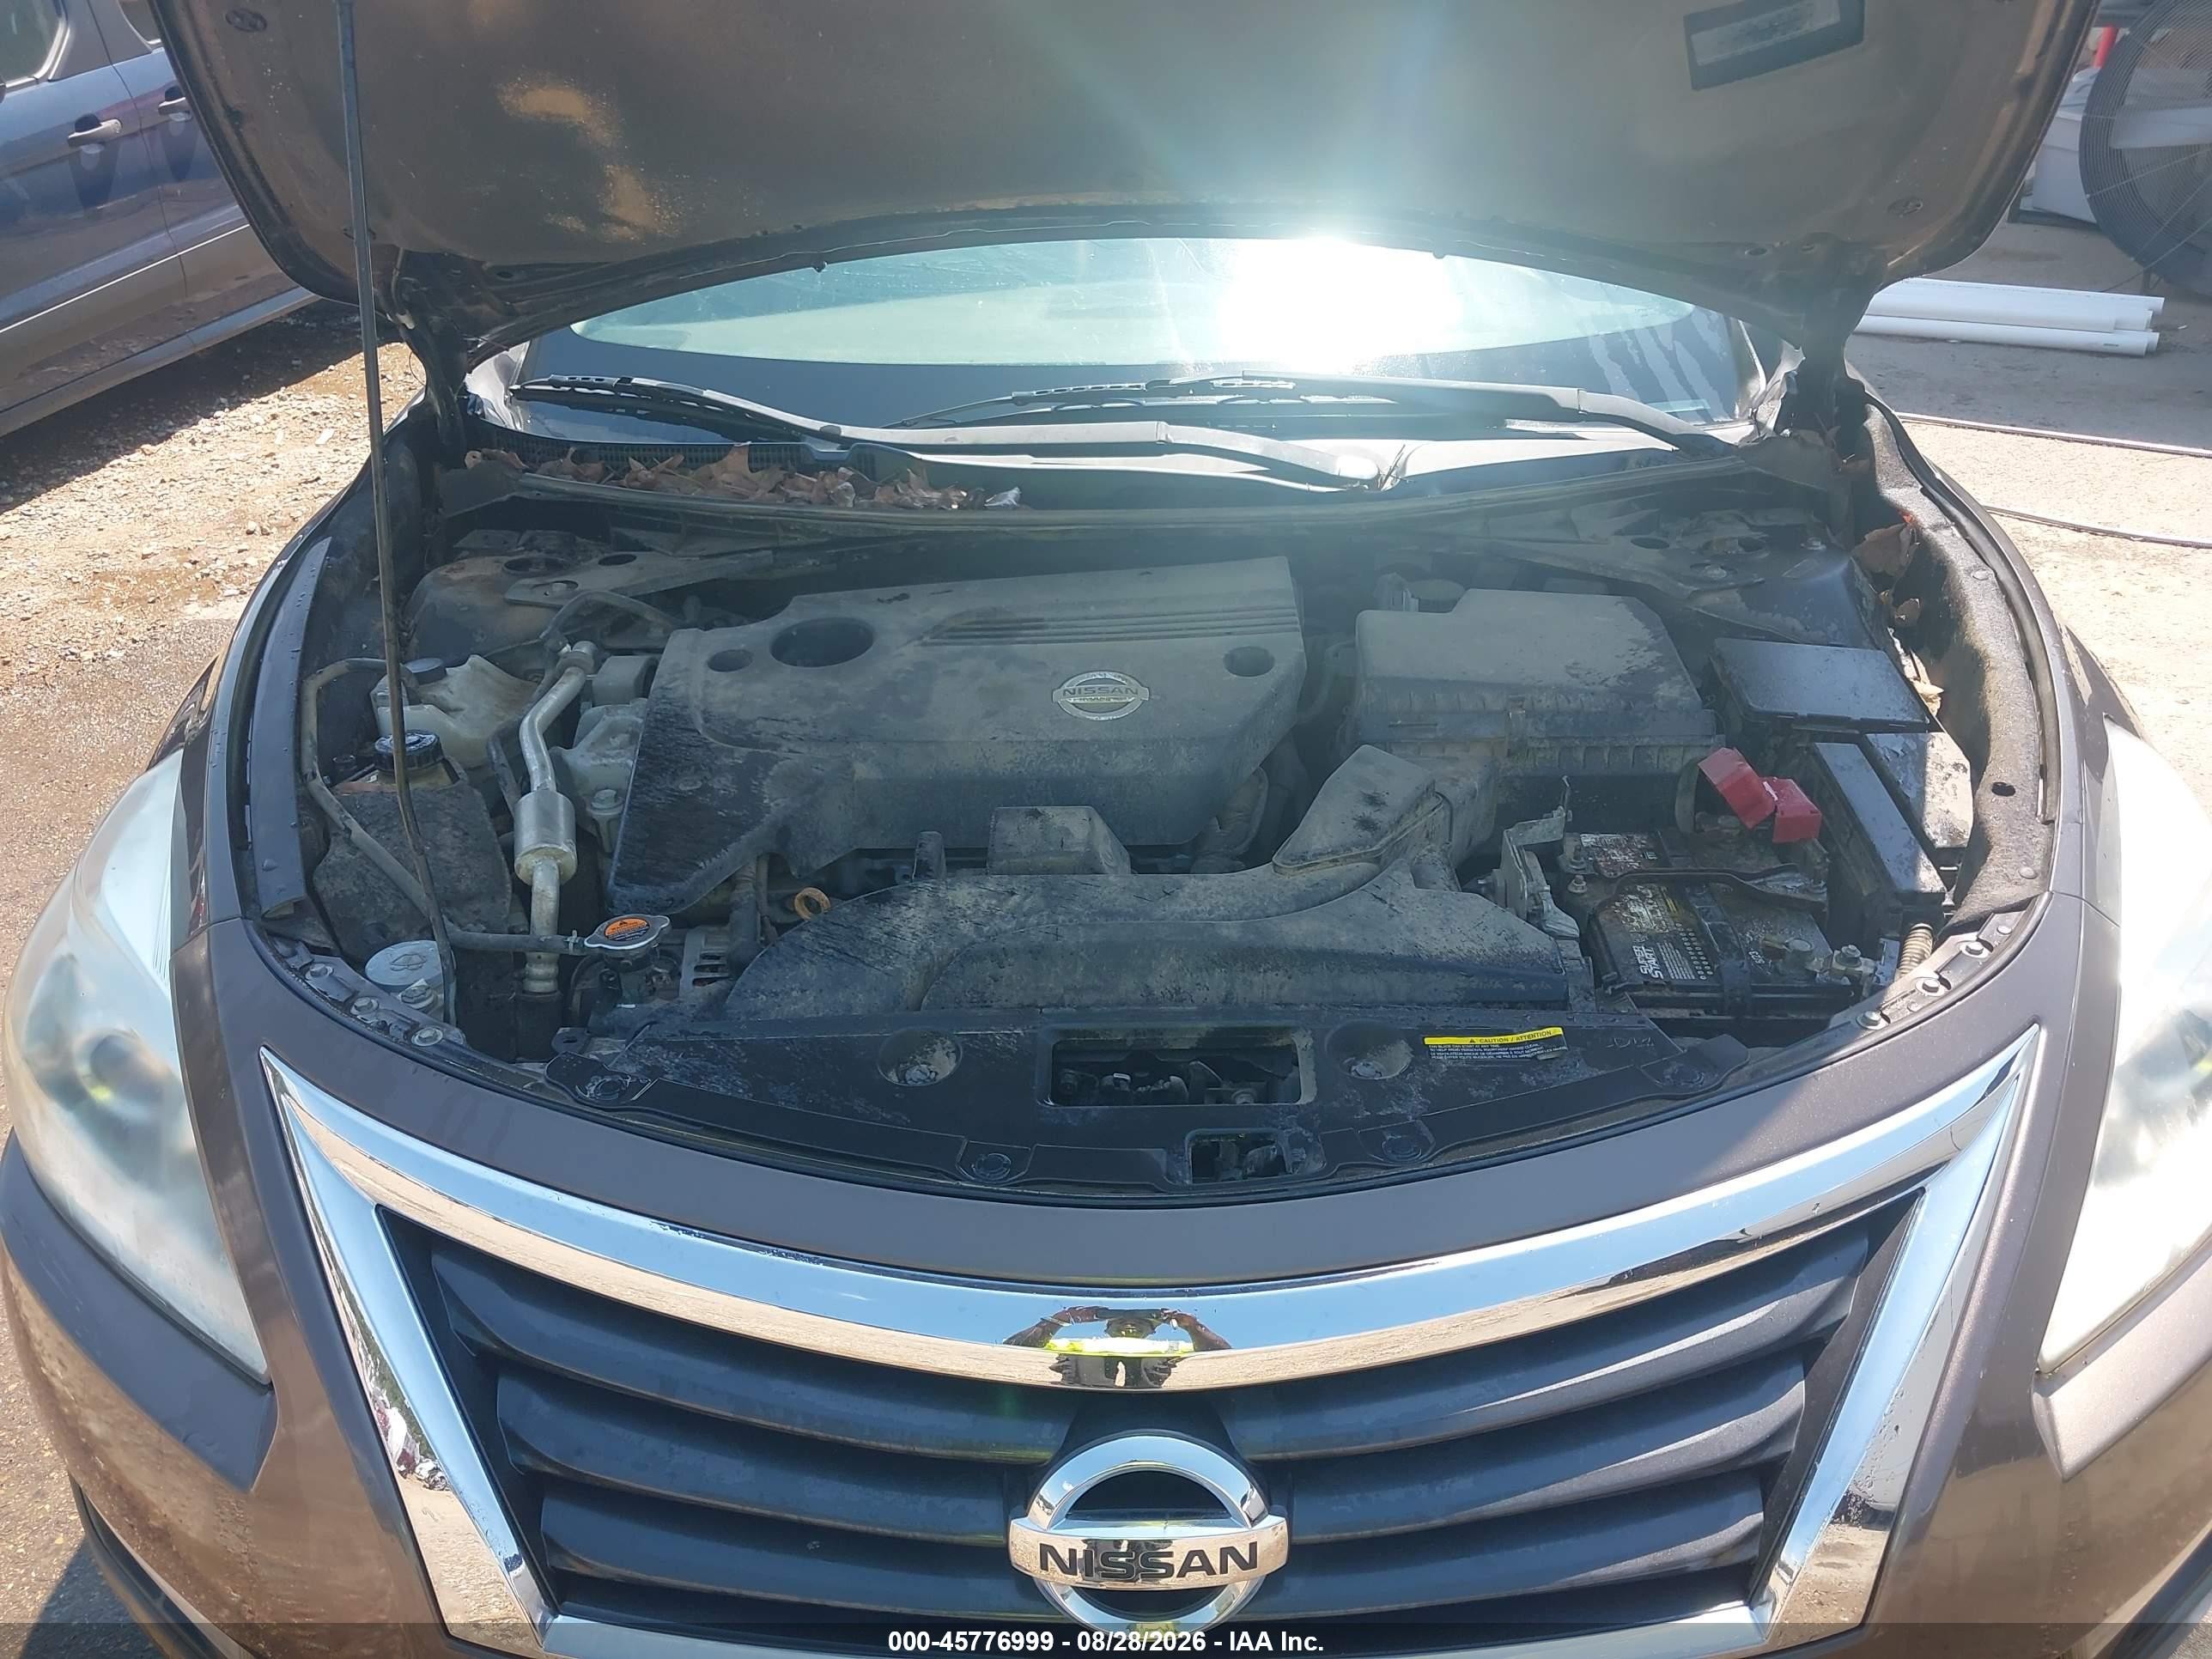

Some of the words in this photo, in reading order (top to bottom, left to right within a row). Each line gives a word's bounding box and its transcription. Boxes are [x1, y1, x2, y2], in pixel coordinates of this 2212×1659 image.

[1063, 687, 1138, 696] NISSAN
[1632, 945, 1650, 975] SUPER
[1642, 945, 1664, 980] START
[1516, 1030, 1552, 1042] ATTENTION
[1039, 1540, 1258, 1580] NISSAN
